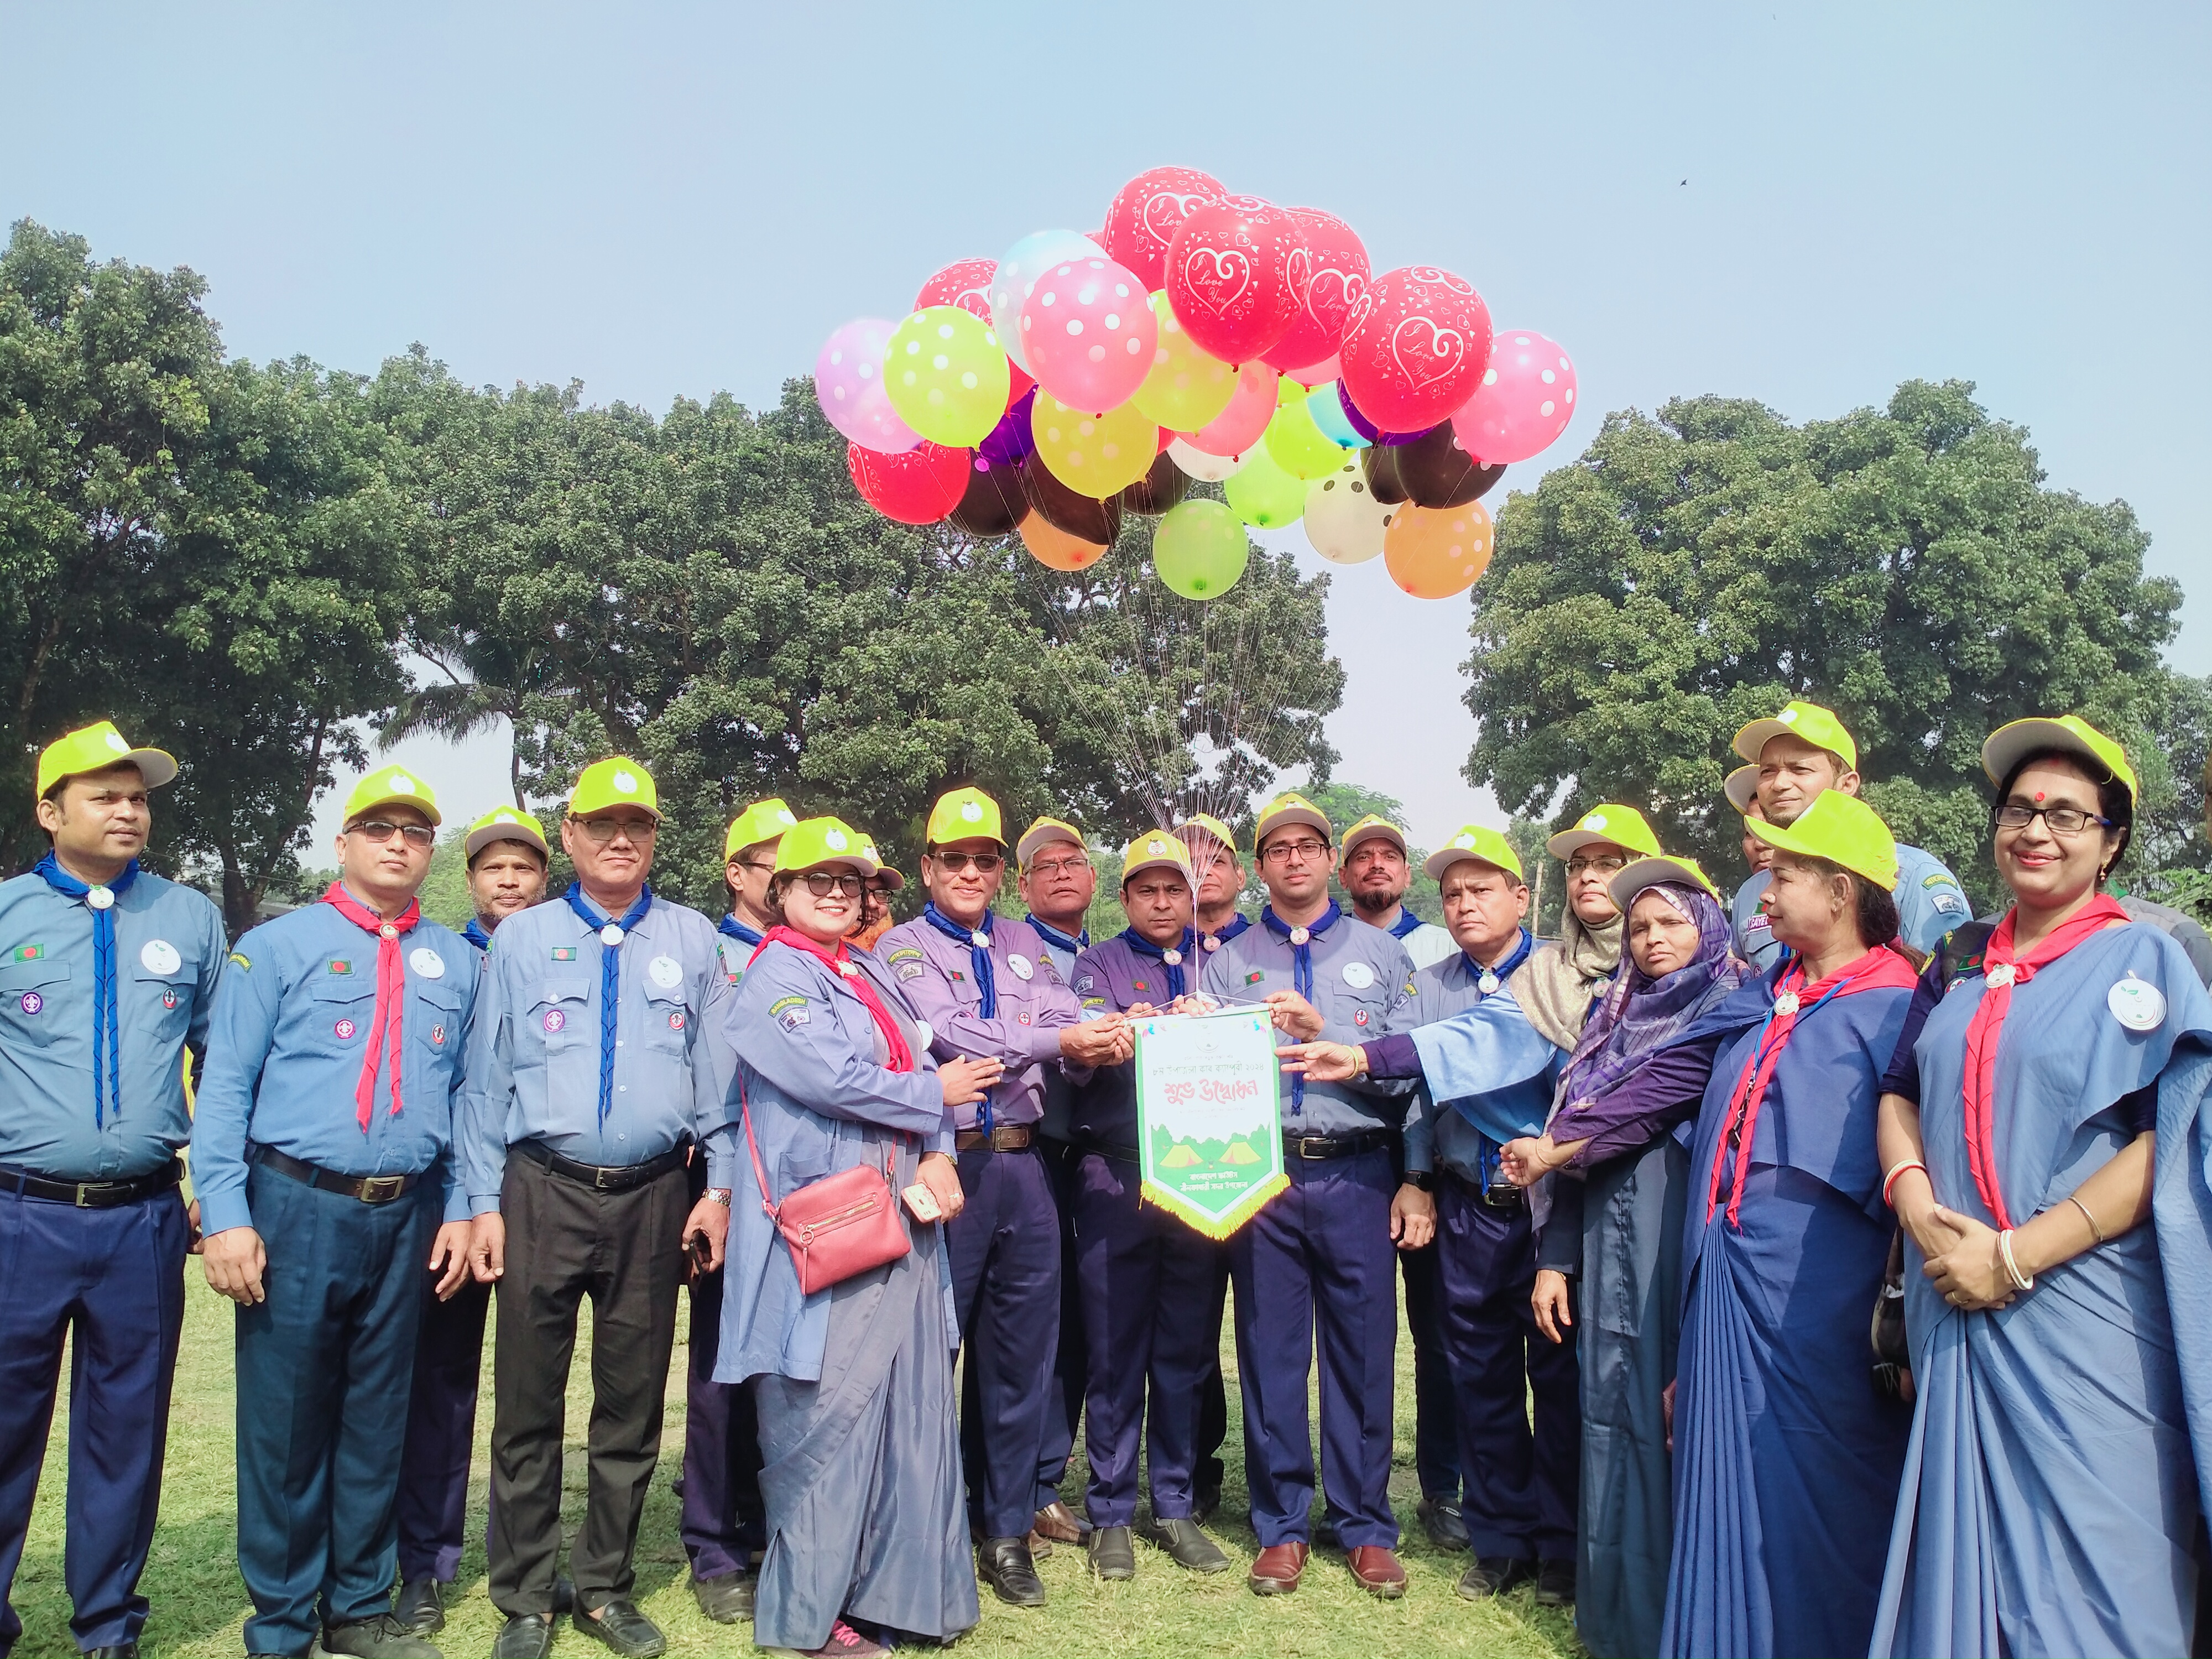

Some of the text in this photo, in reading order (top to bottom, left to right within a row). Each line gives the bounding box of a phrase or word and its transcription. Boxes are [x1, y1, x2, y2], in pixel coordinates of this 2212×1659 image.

[1151, 197, 1166, 213] I
[1156, 211, 1182, 226] Lov
[1192, 254, 1206, 270] I
[1195, 270, 1223, 286] Love
[1316, 276, 1333, 293] I
[1208, 287, 1227, 304] You
[1318, 294, 1346, 311] Love
[1405, 323, 1425, 337] I
[1403, 341, 1434, 362] Love
[1412, 360, 1432, 380] You
[771, 997, 806, 1014] BANGLADESH
[1164, 1079, 1258, 1105] শুভ উদ্বোধন
[1189, 1172, 1217, 1181] বাংলাদেশ
